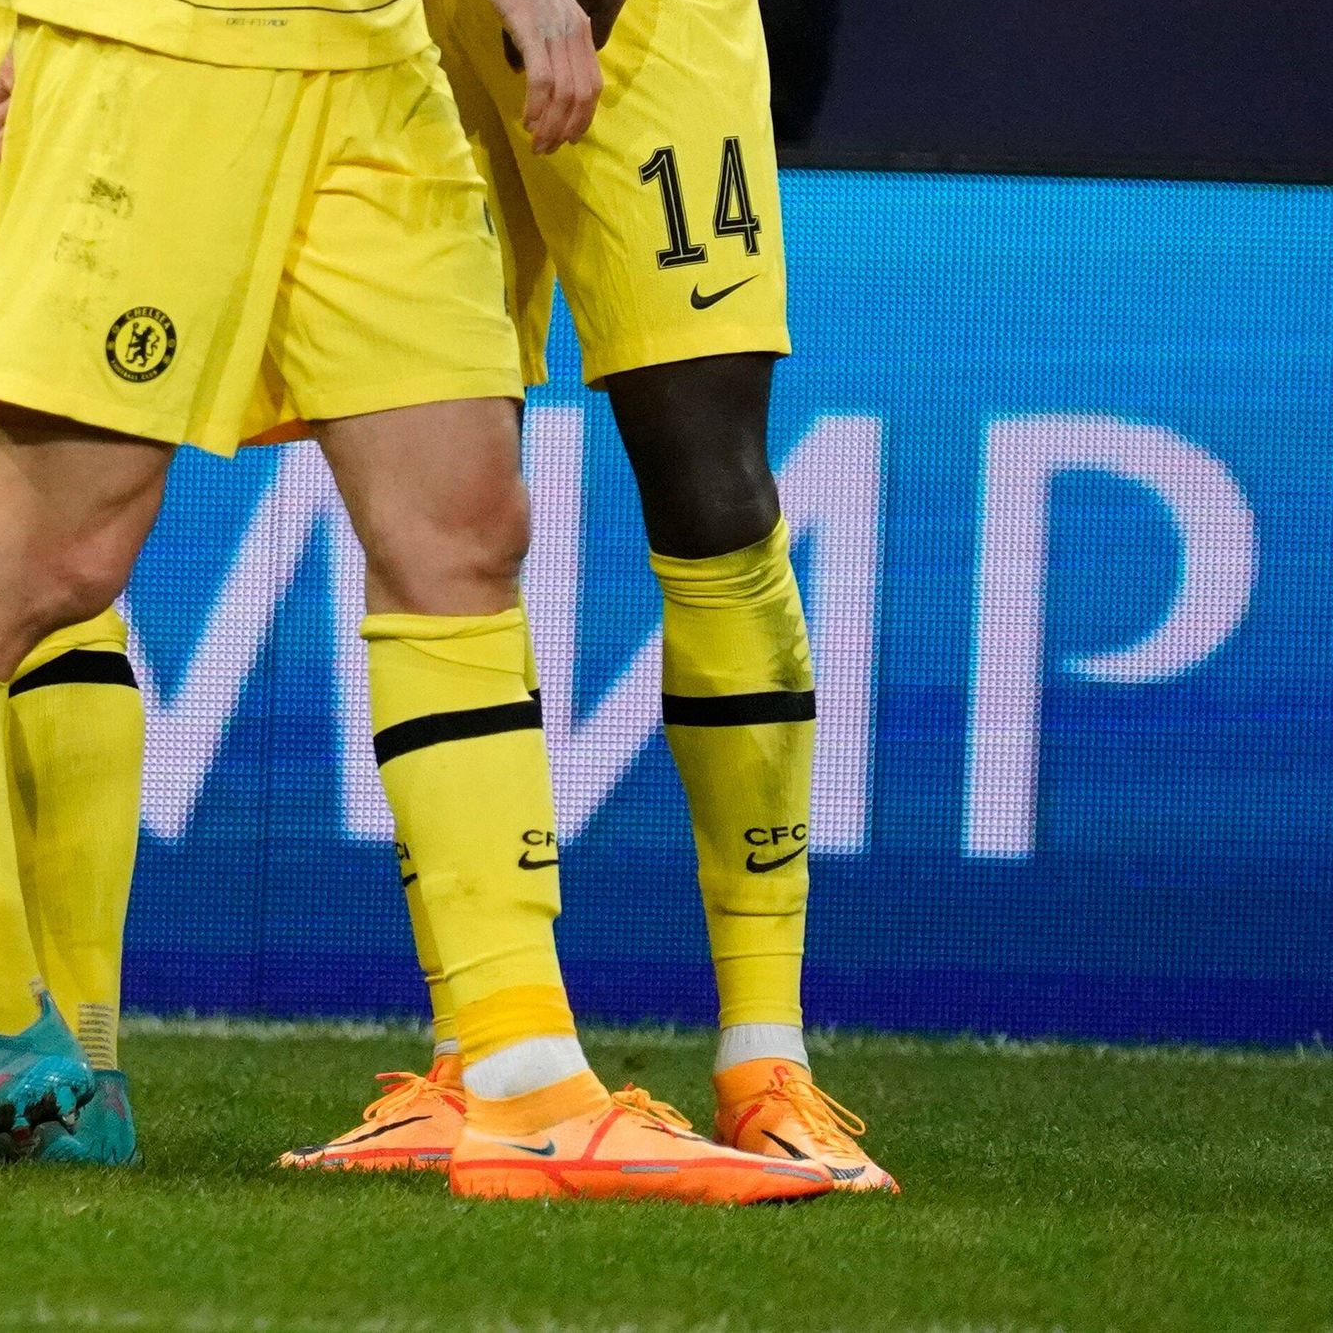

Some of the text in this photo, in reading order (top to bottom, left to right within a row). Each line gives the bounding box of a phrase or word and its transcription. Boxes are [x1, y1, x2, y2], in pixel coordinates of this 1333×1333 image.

[638, 136, 762, 270] 14
[126, 308, 170, 330] CHELSEA
[522, 829, 555, 847] CF
[743, 823, 807, 846] CFC
